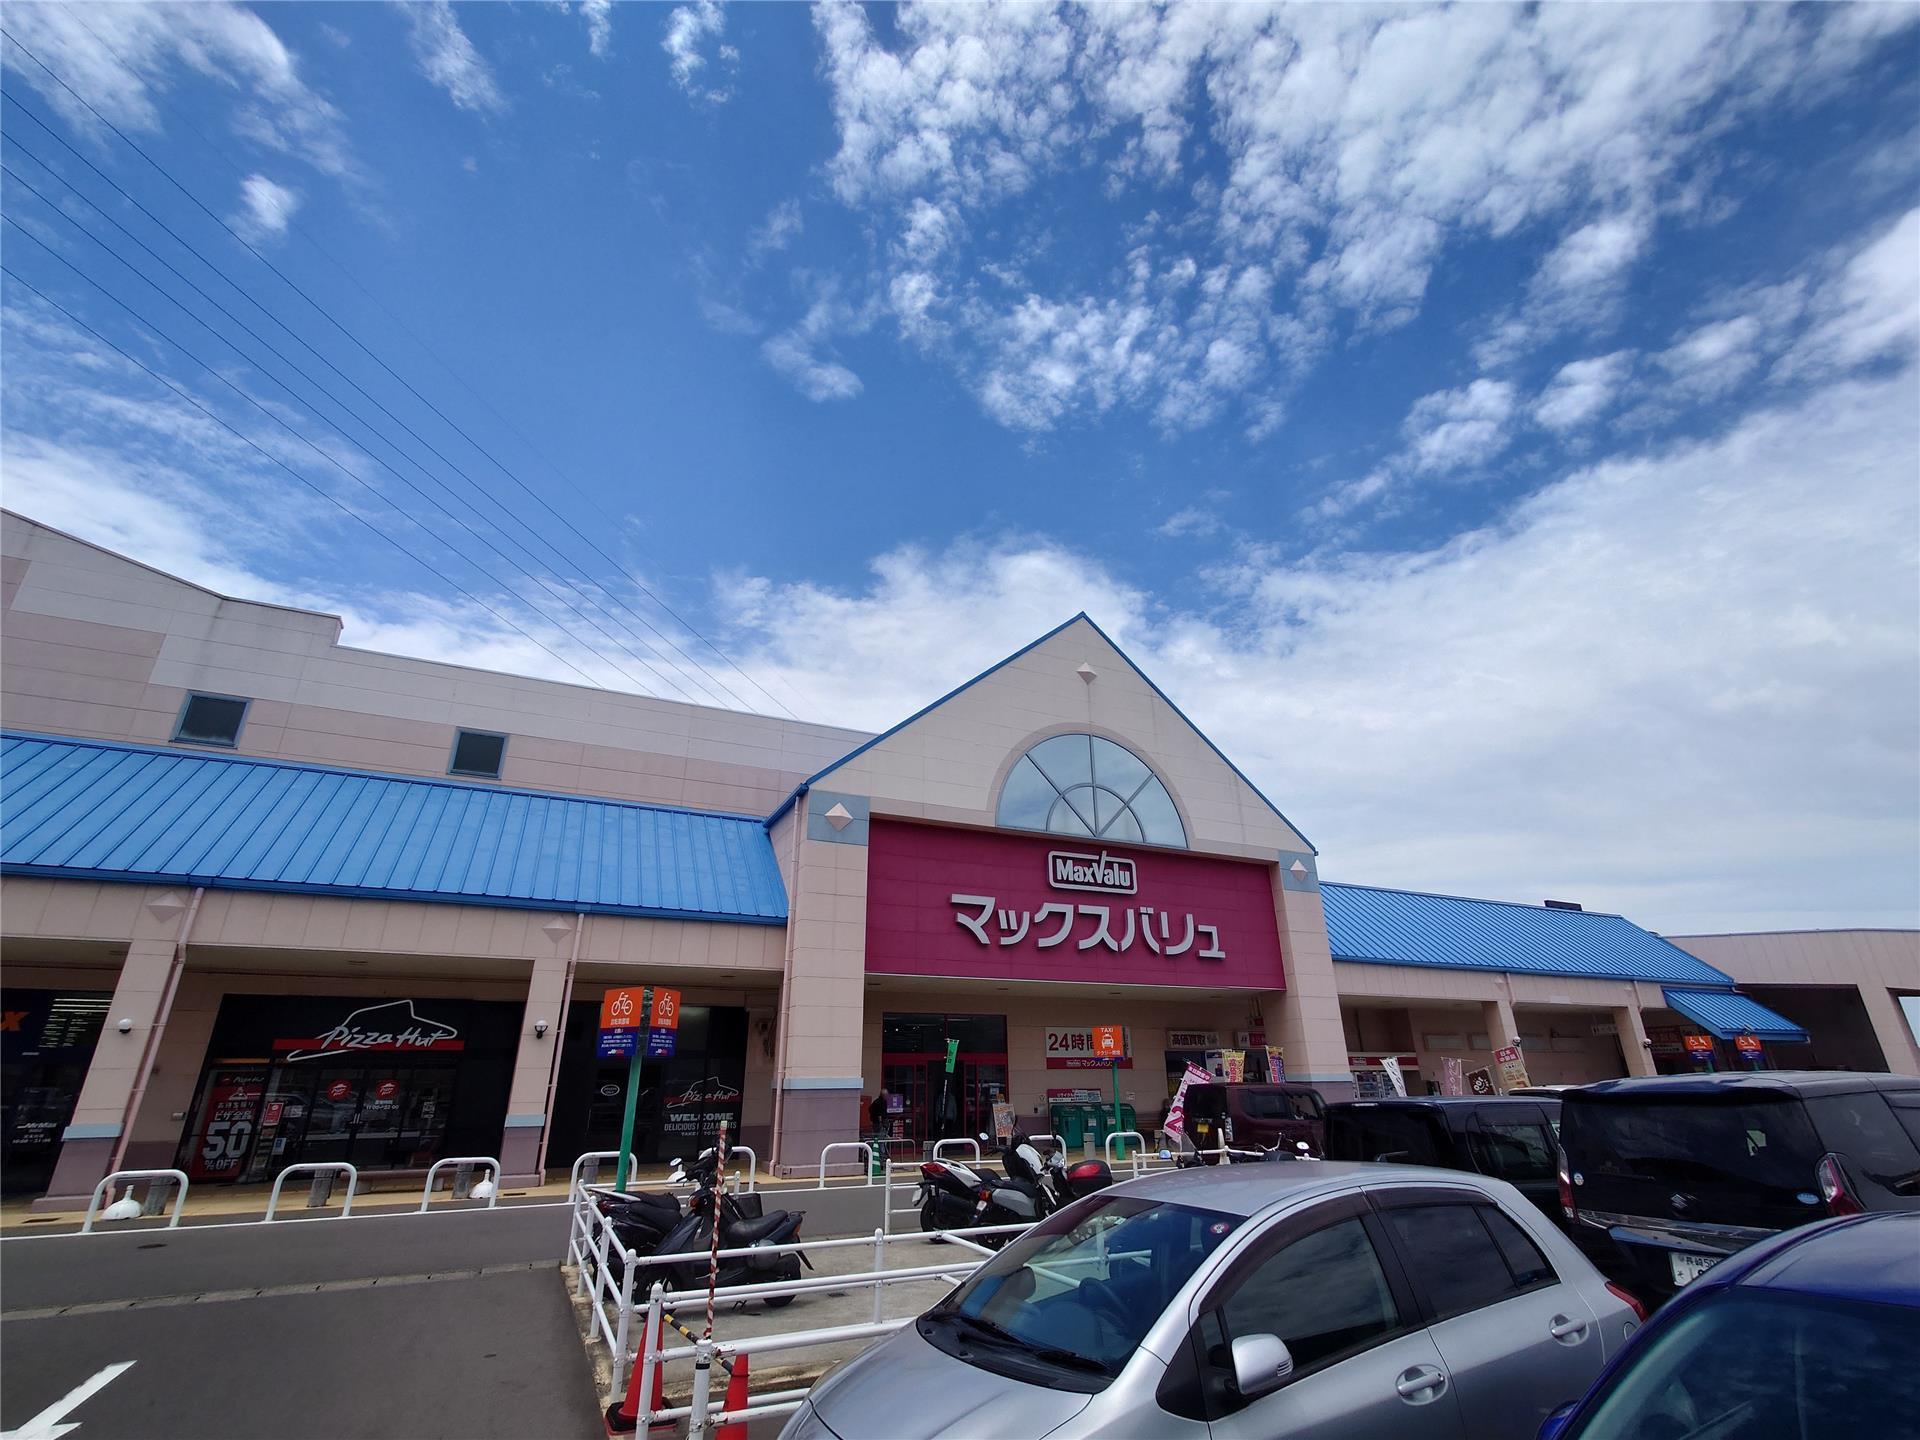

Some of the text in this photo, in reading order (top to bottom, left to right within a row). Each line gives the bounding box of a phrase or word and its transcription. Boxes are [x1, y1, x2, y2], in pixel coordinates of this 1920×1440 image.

[1055, 850, 1132, 888] MaxValu
[951, 893, 1226, 959] マックスバリュ
[314, 1025, 449, 1050] Pizza Hut
[663, 1121, 696, 1131] DELICIOUS
[669, 1112, 734, 1122] WELCOME
[202, 1120, 252, 1159] 50
